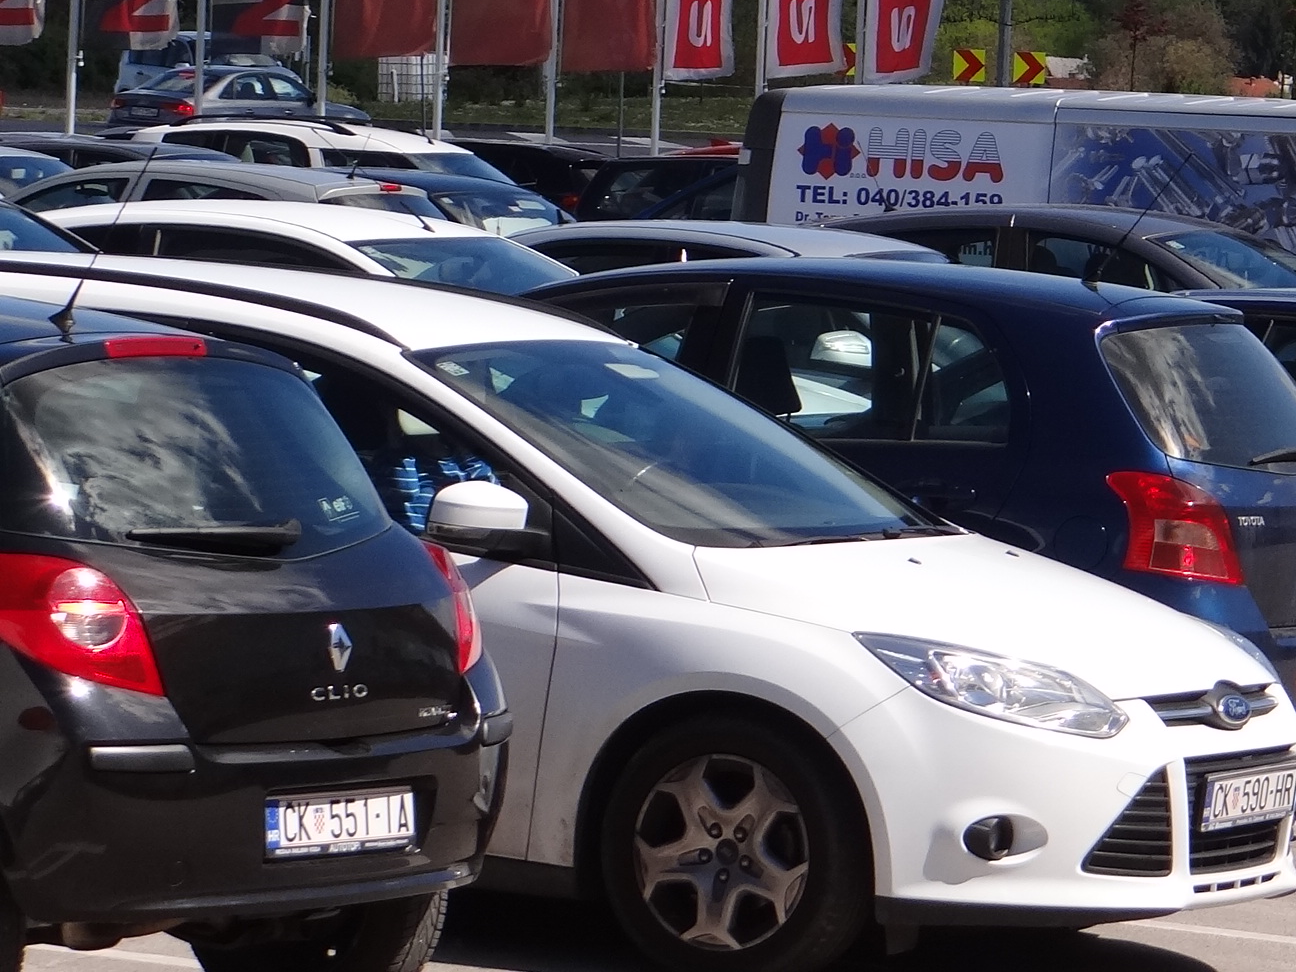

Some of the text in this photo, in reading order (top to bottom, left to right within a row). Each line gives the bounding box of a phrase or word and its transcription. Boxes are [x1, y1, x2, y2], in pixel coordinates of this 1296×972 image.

[866, 126, 1004, 184] HISA
[796, 184, 848, 205] TEL:
[1238, 516, 1265, 526] TOYOTA
[311, 684, 367, 701] CLIO
[1240, 772, 1295, 814] 590-HR
[329, 794, 410, 838] 551-IA
[267, 830, 281, 842] HR
